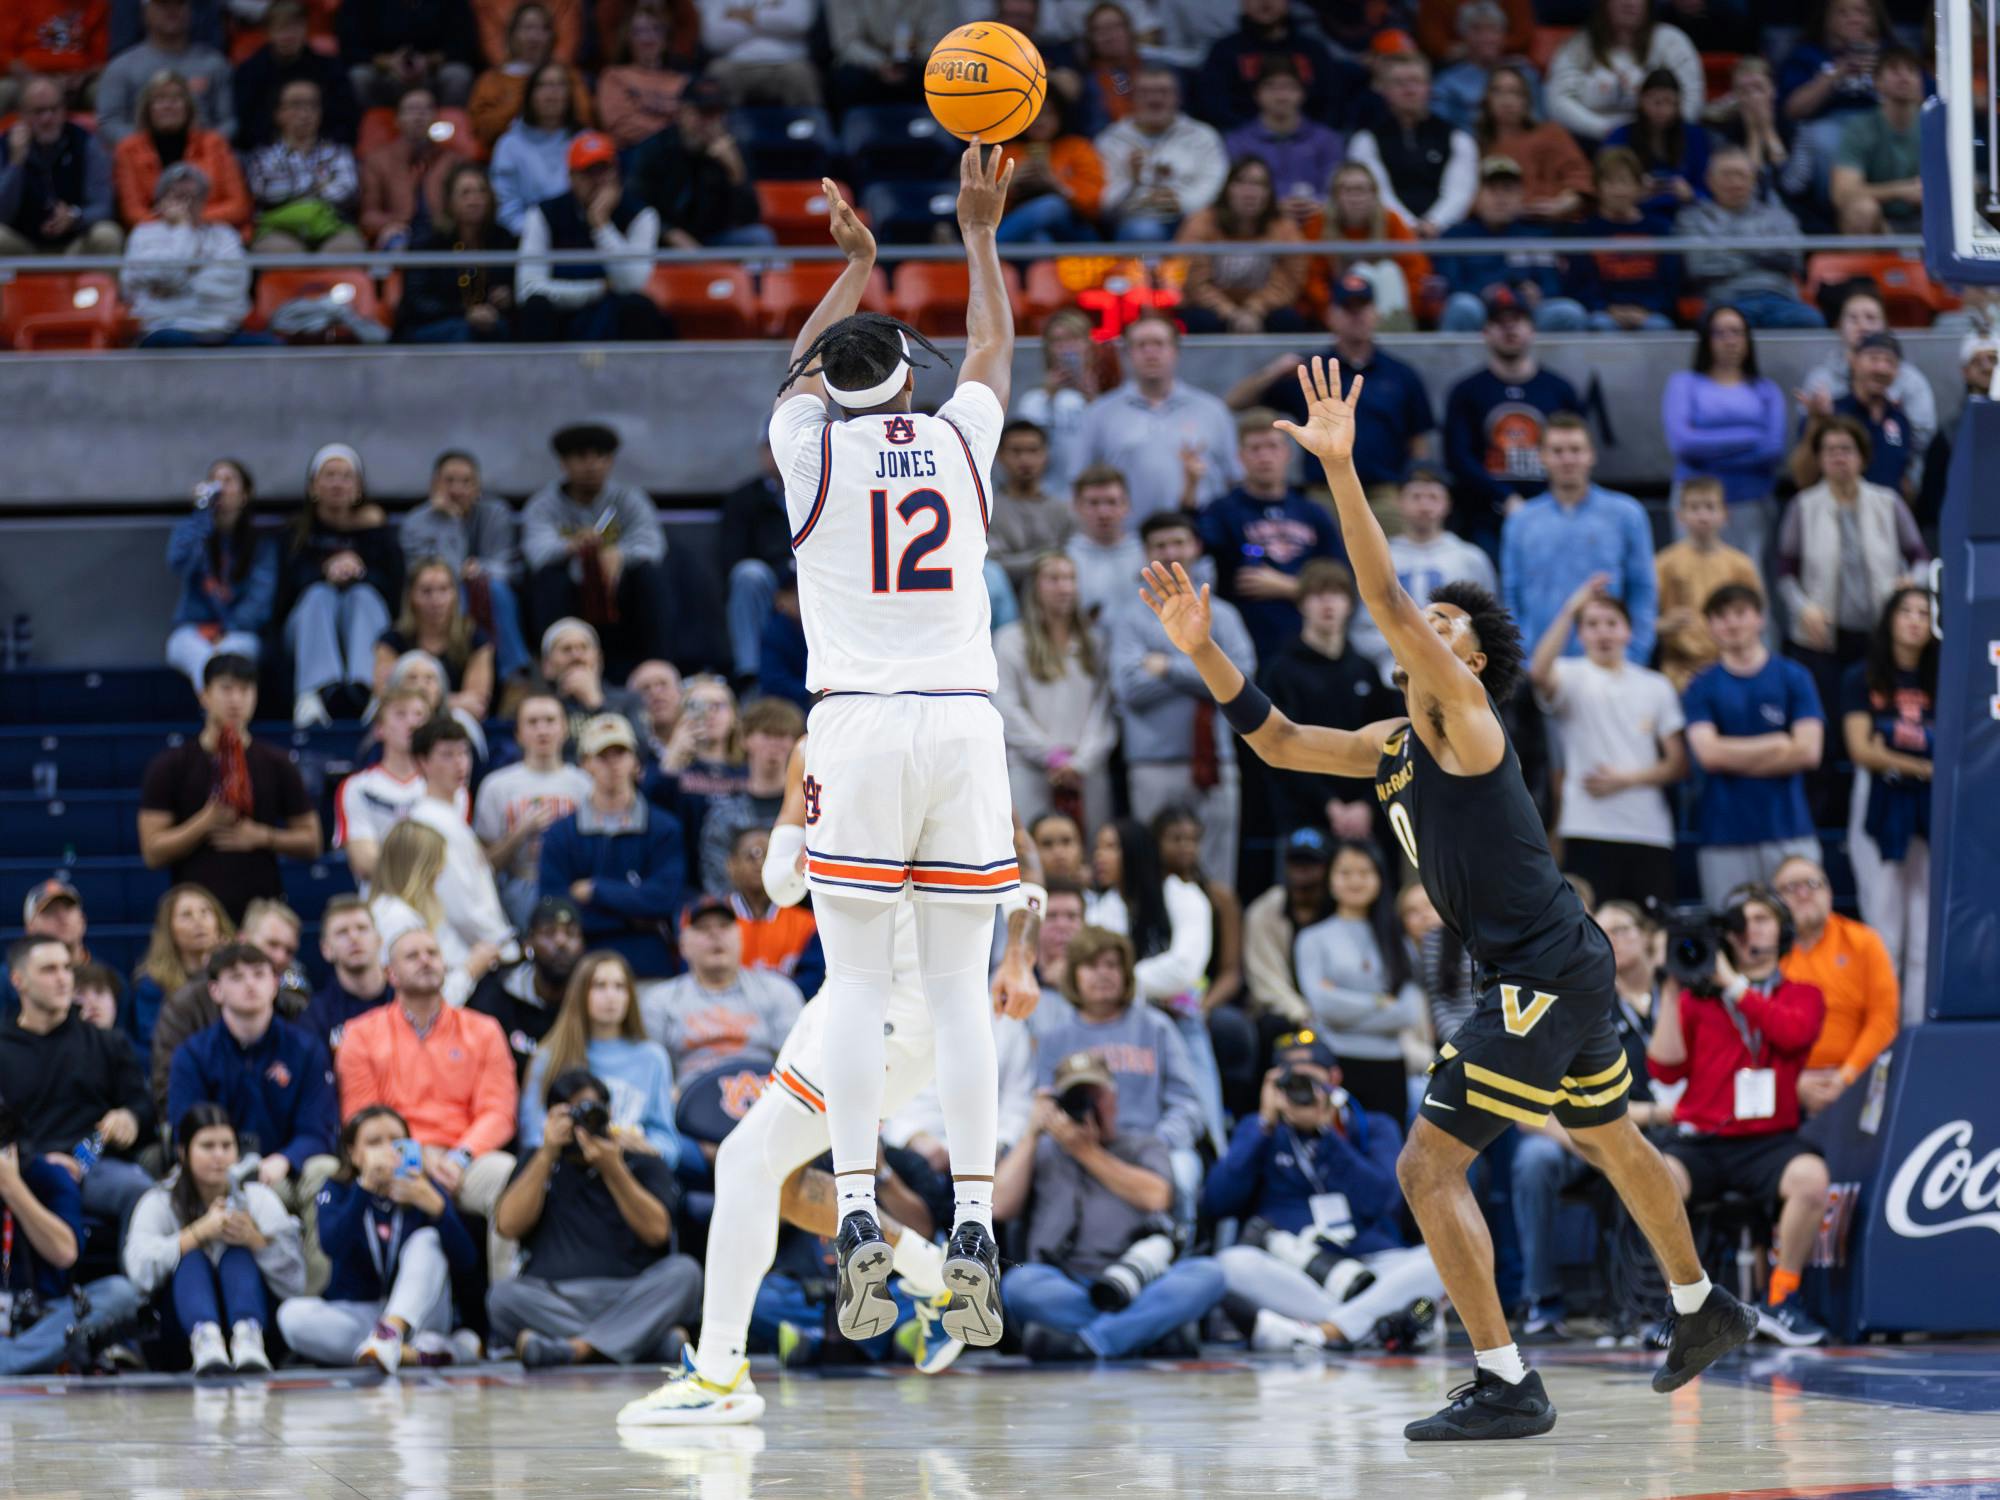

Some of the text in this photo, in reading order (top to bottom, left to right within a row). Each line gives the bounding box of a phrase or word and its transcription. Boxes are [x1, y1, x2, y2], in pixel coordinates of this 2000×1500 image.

[926, 58, 989, 84] Wilson
[875, 450, 937, 479] JONES
[869, 487, 954, 594] 12
[1388, 801, 1420, 870] 0
[1499, 983, 1560, 1038] V
